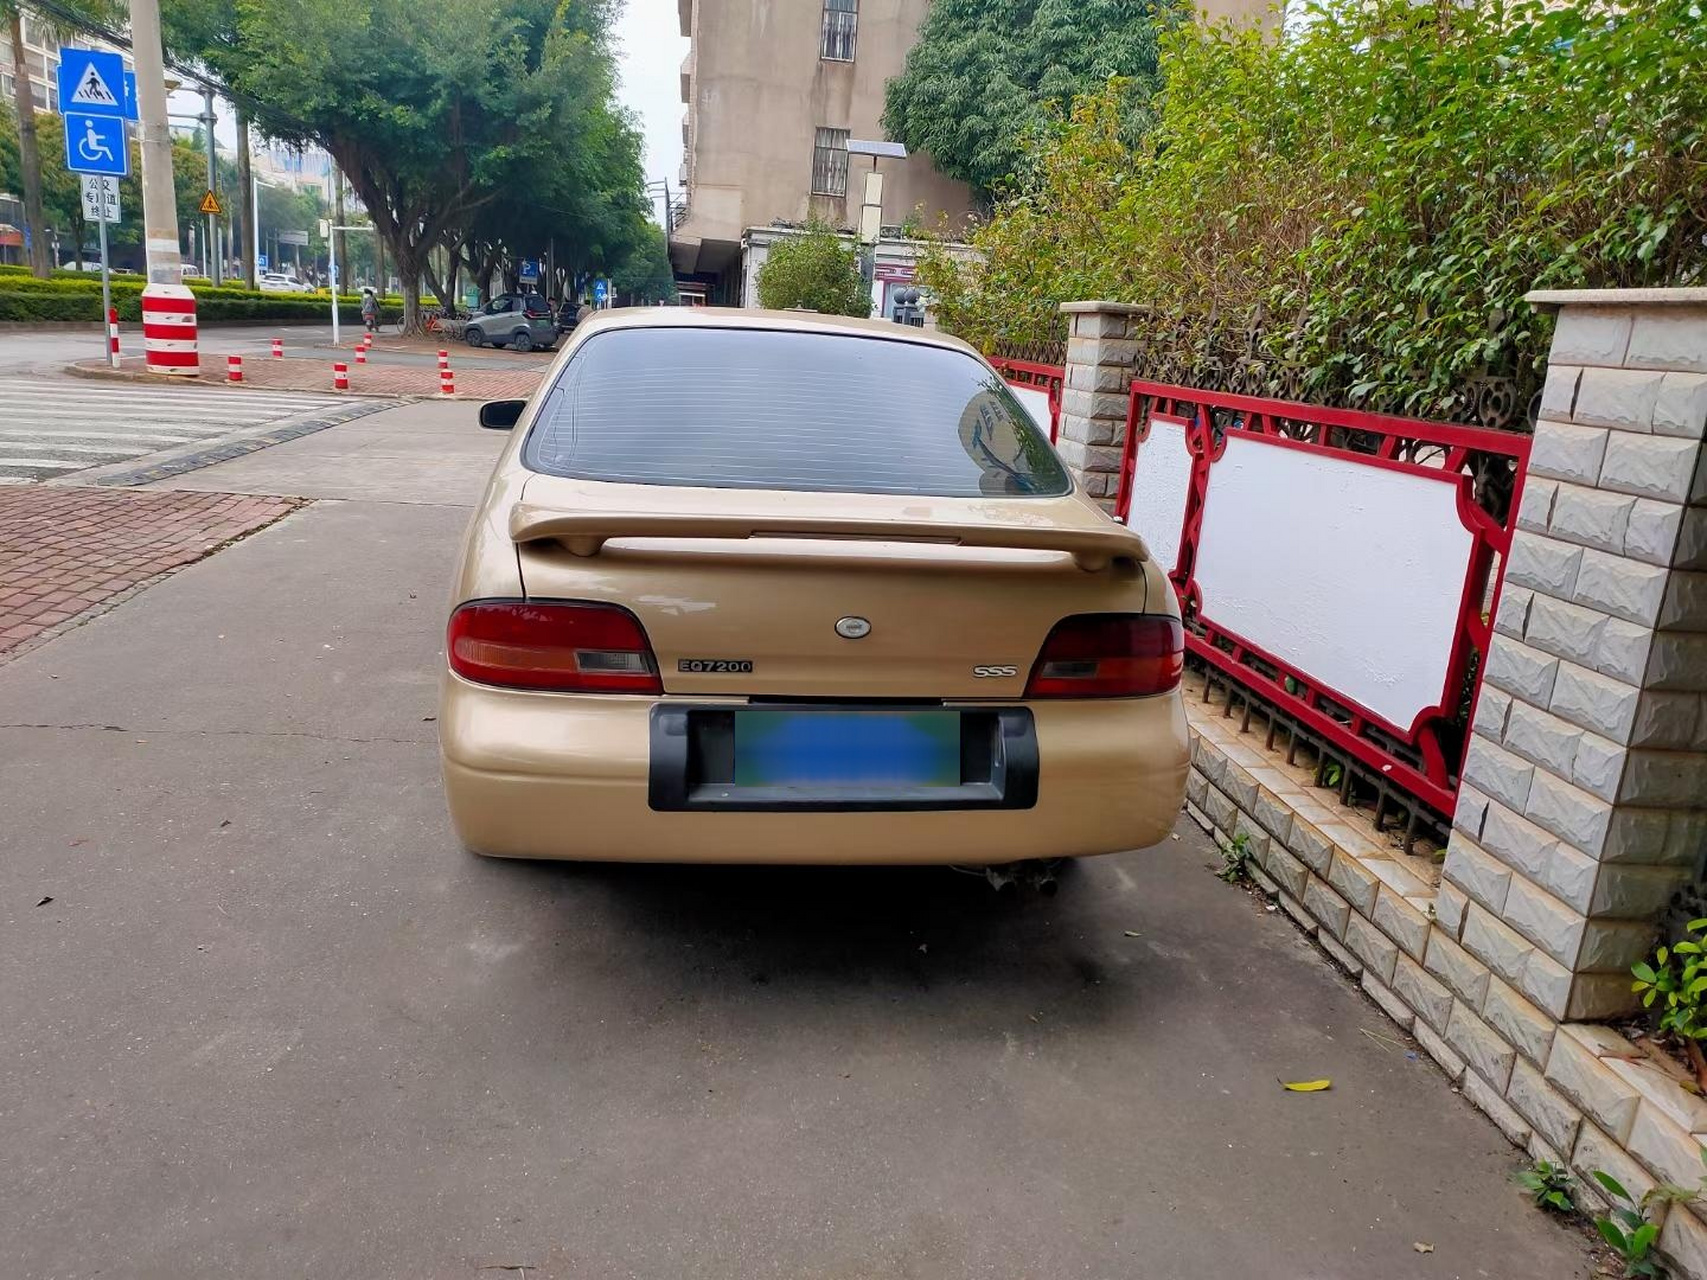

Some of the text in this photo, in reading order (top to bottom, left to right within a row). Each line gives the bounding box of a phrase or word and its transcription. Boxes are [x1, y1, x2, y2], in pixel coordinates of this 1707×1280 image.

[89, 178, 111, 191] 公交
[86, 192, 116, 205] 专道
[679, 660, 752, 672] EQ7200
[974, 665, 1017, 678] SSS
